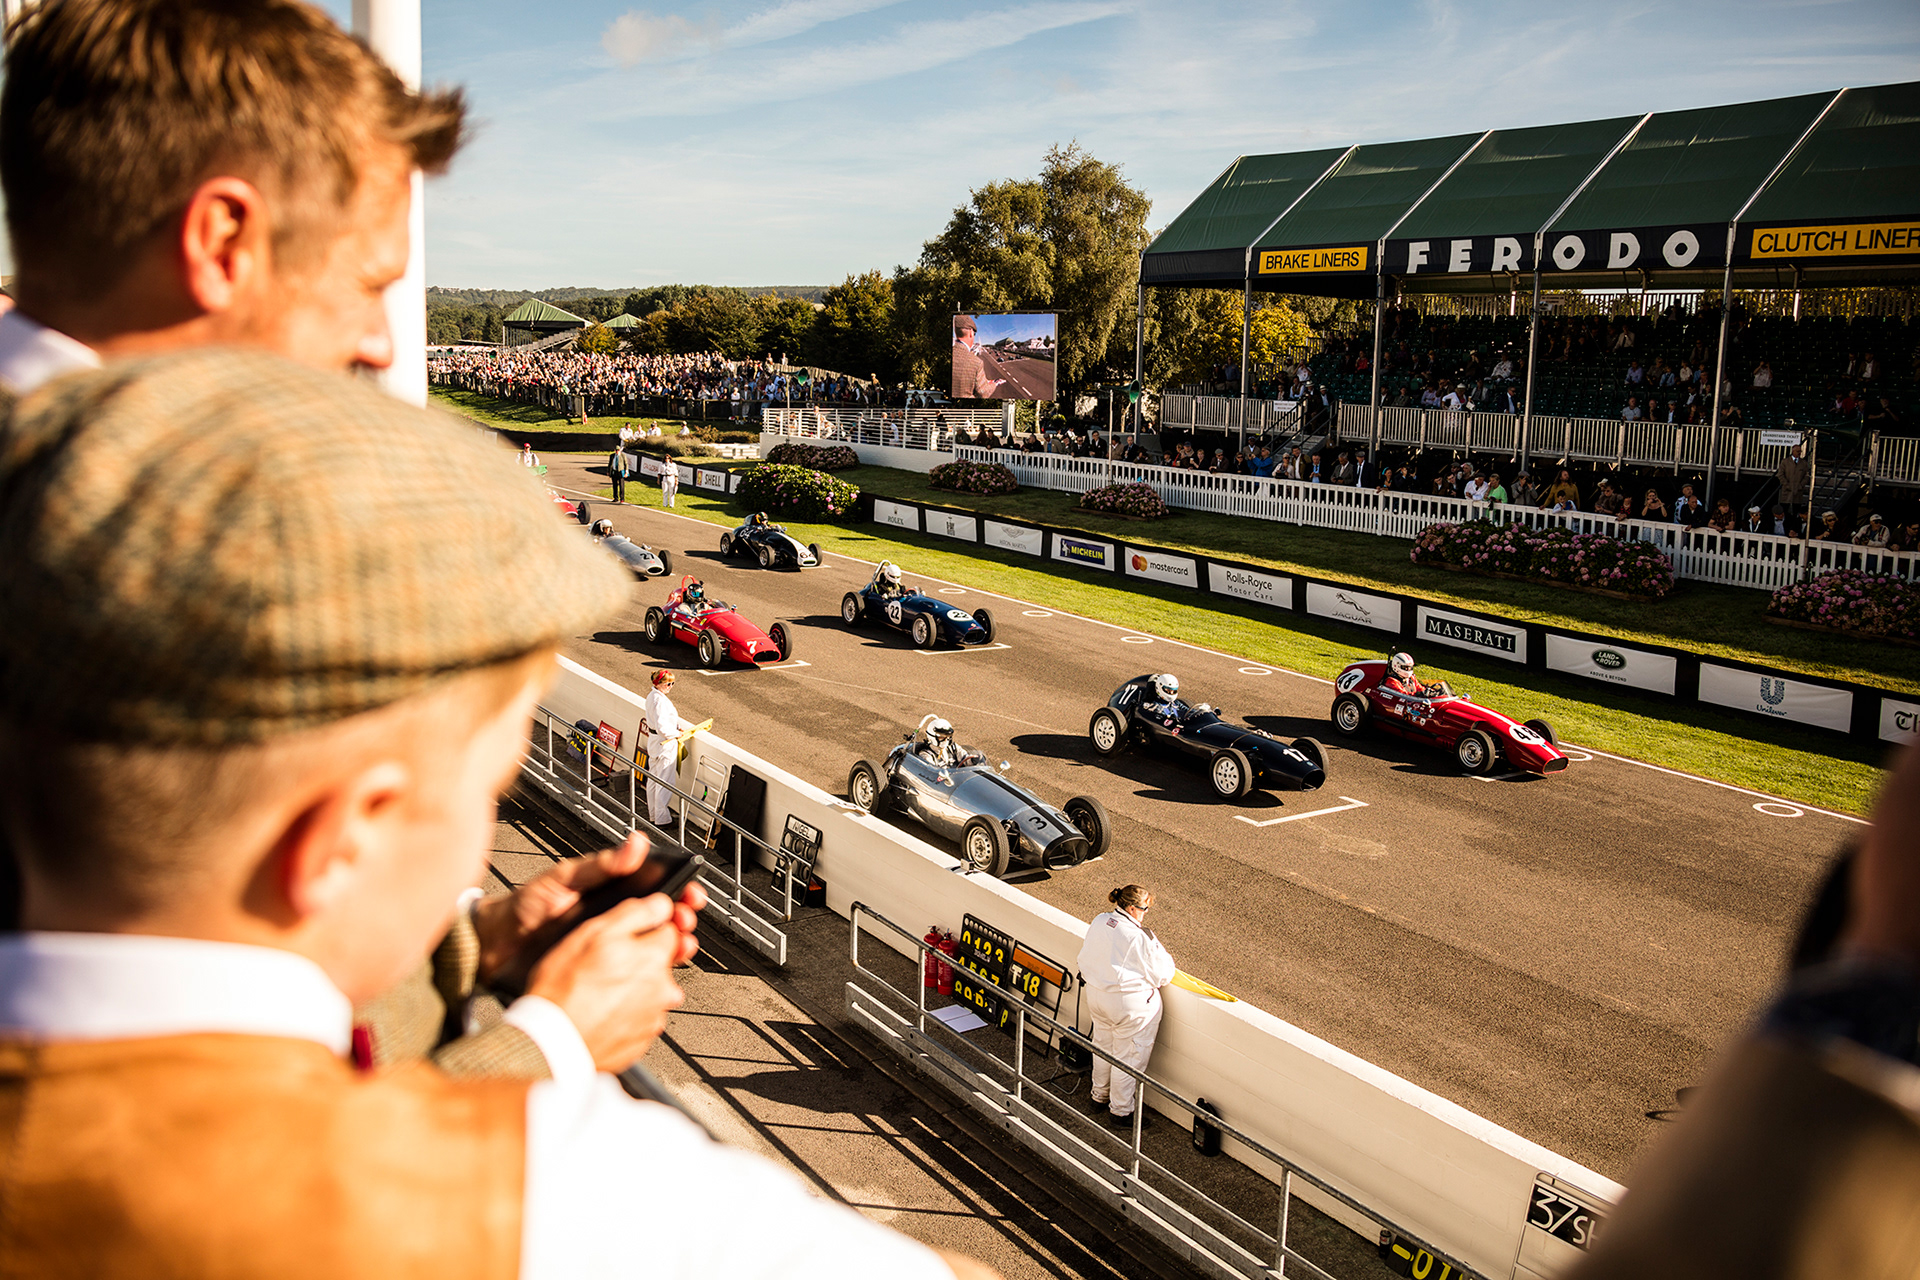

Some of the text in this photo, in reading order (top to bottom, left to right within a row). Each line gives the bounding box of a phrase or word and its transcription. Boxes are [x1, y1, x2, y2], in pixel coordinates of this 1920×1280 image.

[1758, 228, 1920, 253] CLUTCH LINER
[1406, 230, 1700, 274] FERODO
[1266, 251, 1359, 269] BRAKE LINERS
[705, 473, 721, 487] SHELL
[888, 515, 904, 525] ROLEX
[1071, 546, 1103, 560] MICHELIN
[1150, 561, 1188, 576] mastercard
[1226, 570, 1272, 591] Rolls-Royce
[1227, 584, 1274, 601] Motor Cars
[890, 605, 899, 620] 22
[1332, 610, 1372, 625] JAGUAR
[1428, 620, 1512, 650] MASERATI
[747, 641, 757, 654] 7
[1118, 684, 1138, 705] 17
[1756, 704, 1787, 716] Unilever
[1029, 816, 1047, 830] 3
